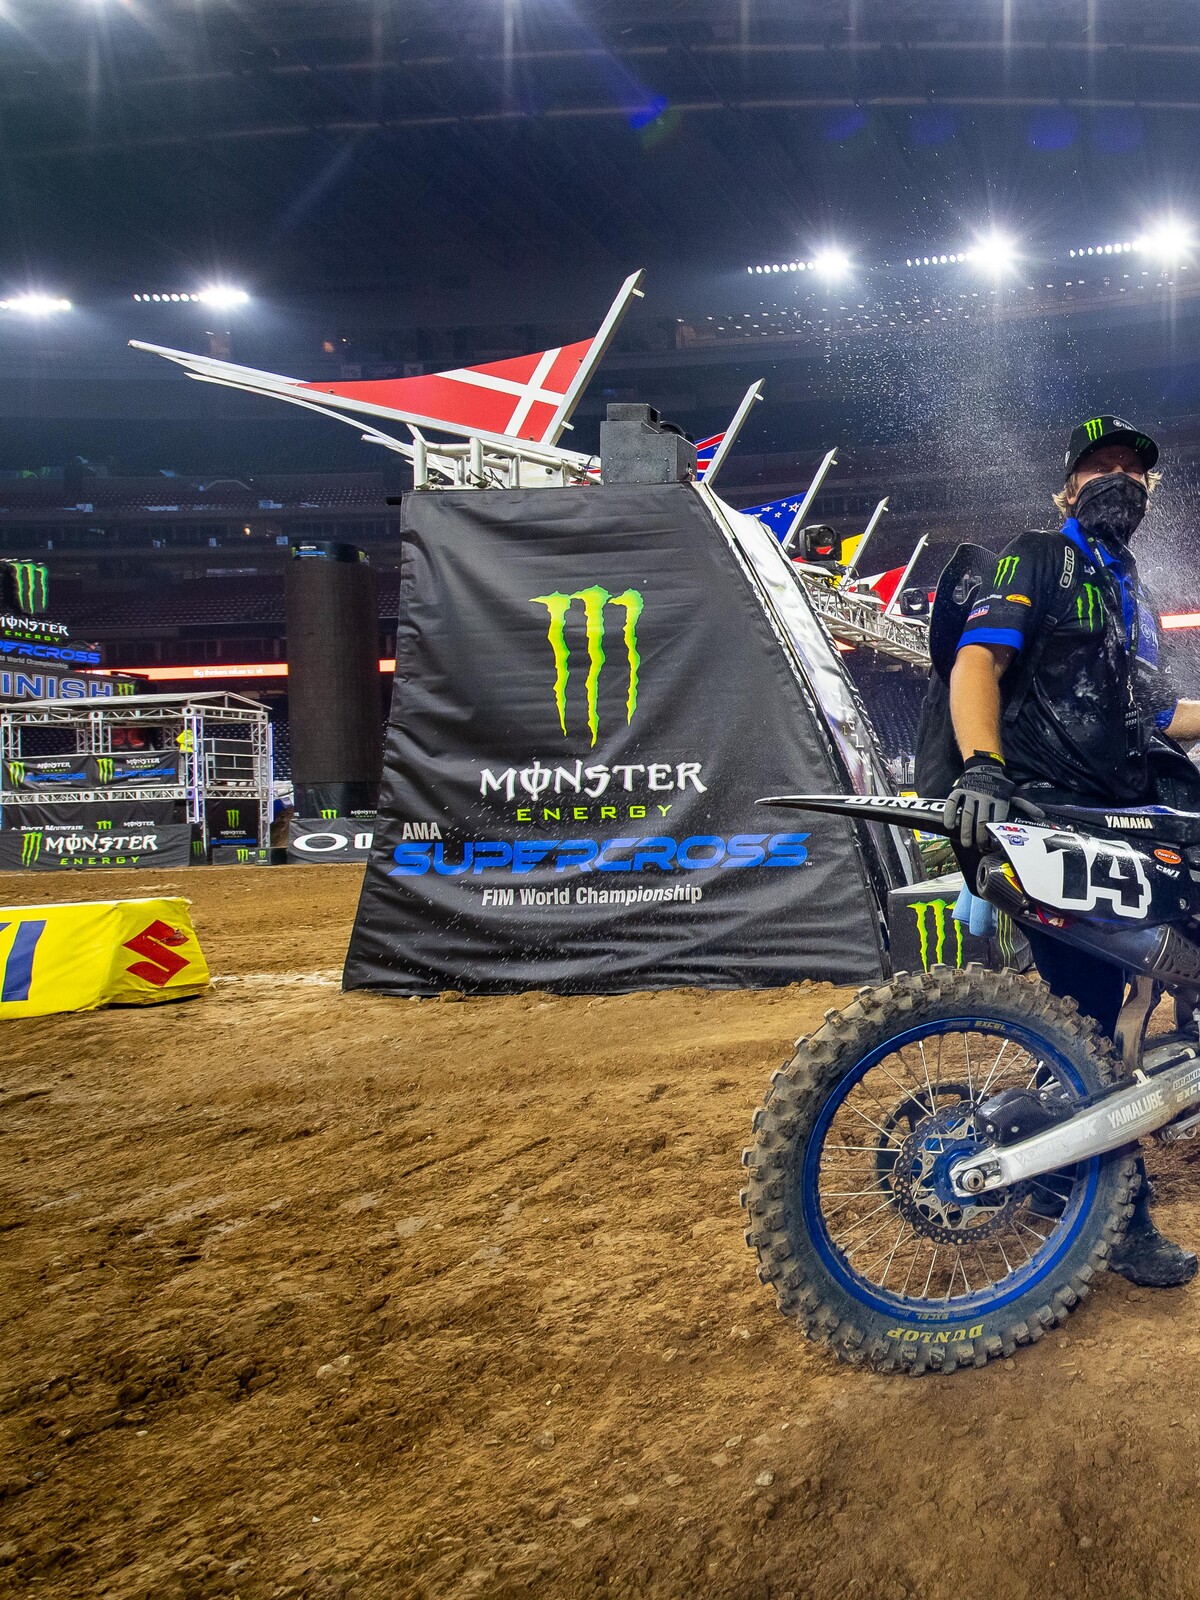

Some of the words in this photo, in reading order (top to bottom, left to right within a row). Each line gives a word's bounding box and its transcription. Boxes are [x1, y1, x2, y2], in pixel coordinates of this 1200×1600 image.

[5, 630, 60, 642] ENERGY
[0, 640, 101, 664] ERCROSS
[479, 759, 708, 801] MONSTER
[516, 804, 673, 822] ENERGY
[844, 797, 963, 814] DUNLO
[402, 822, 442, 841] AMA
[1105, 815, 1153, 830] YAMAHA
[45, 833, 158, 855] MONSTER
[60, 856, 139, 865] ENERGY
[388, 833, 812, 877] SUPERCROSS
[1043, 834, 1146, 912] 14
[481, 887, 514, 906] FIM
[519, 886, 571, 906] World
[576, 883, 702, 906] Championship
[975, 1021, 1006, 1031] EXCEL
[1107, 1090, 1163, 1129] YAMALUBE
[887, 1324, 984, 1343] DUNLOP
